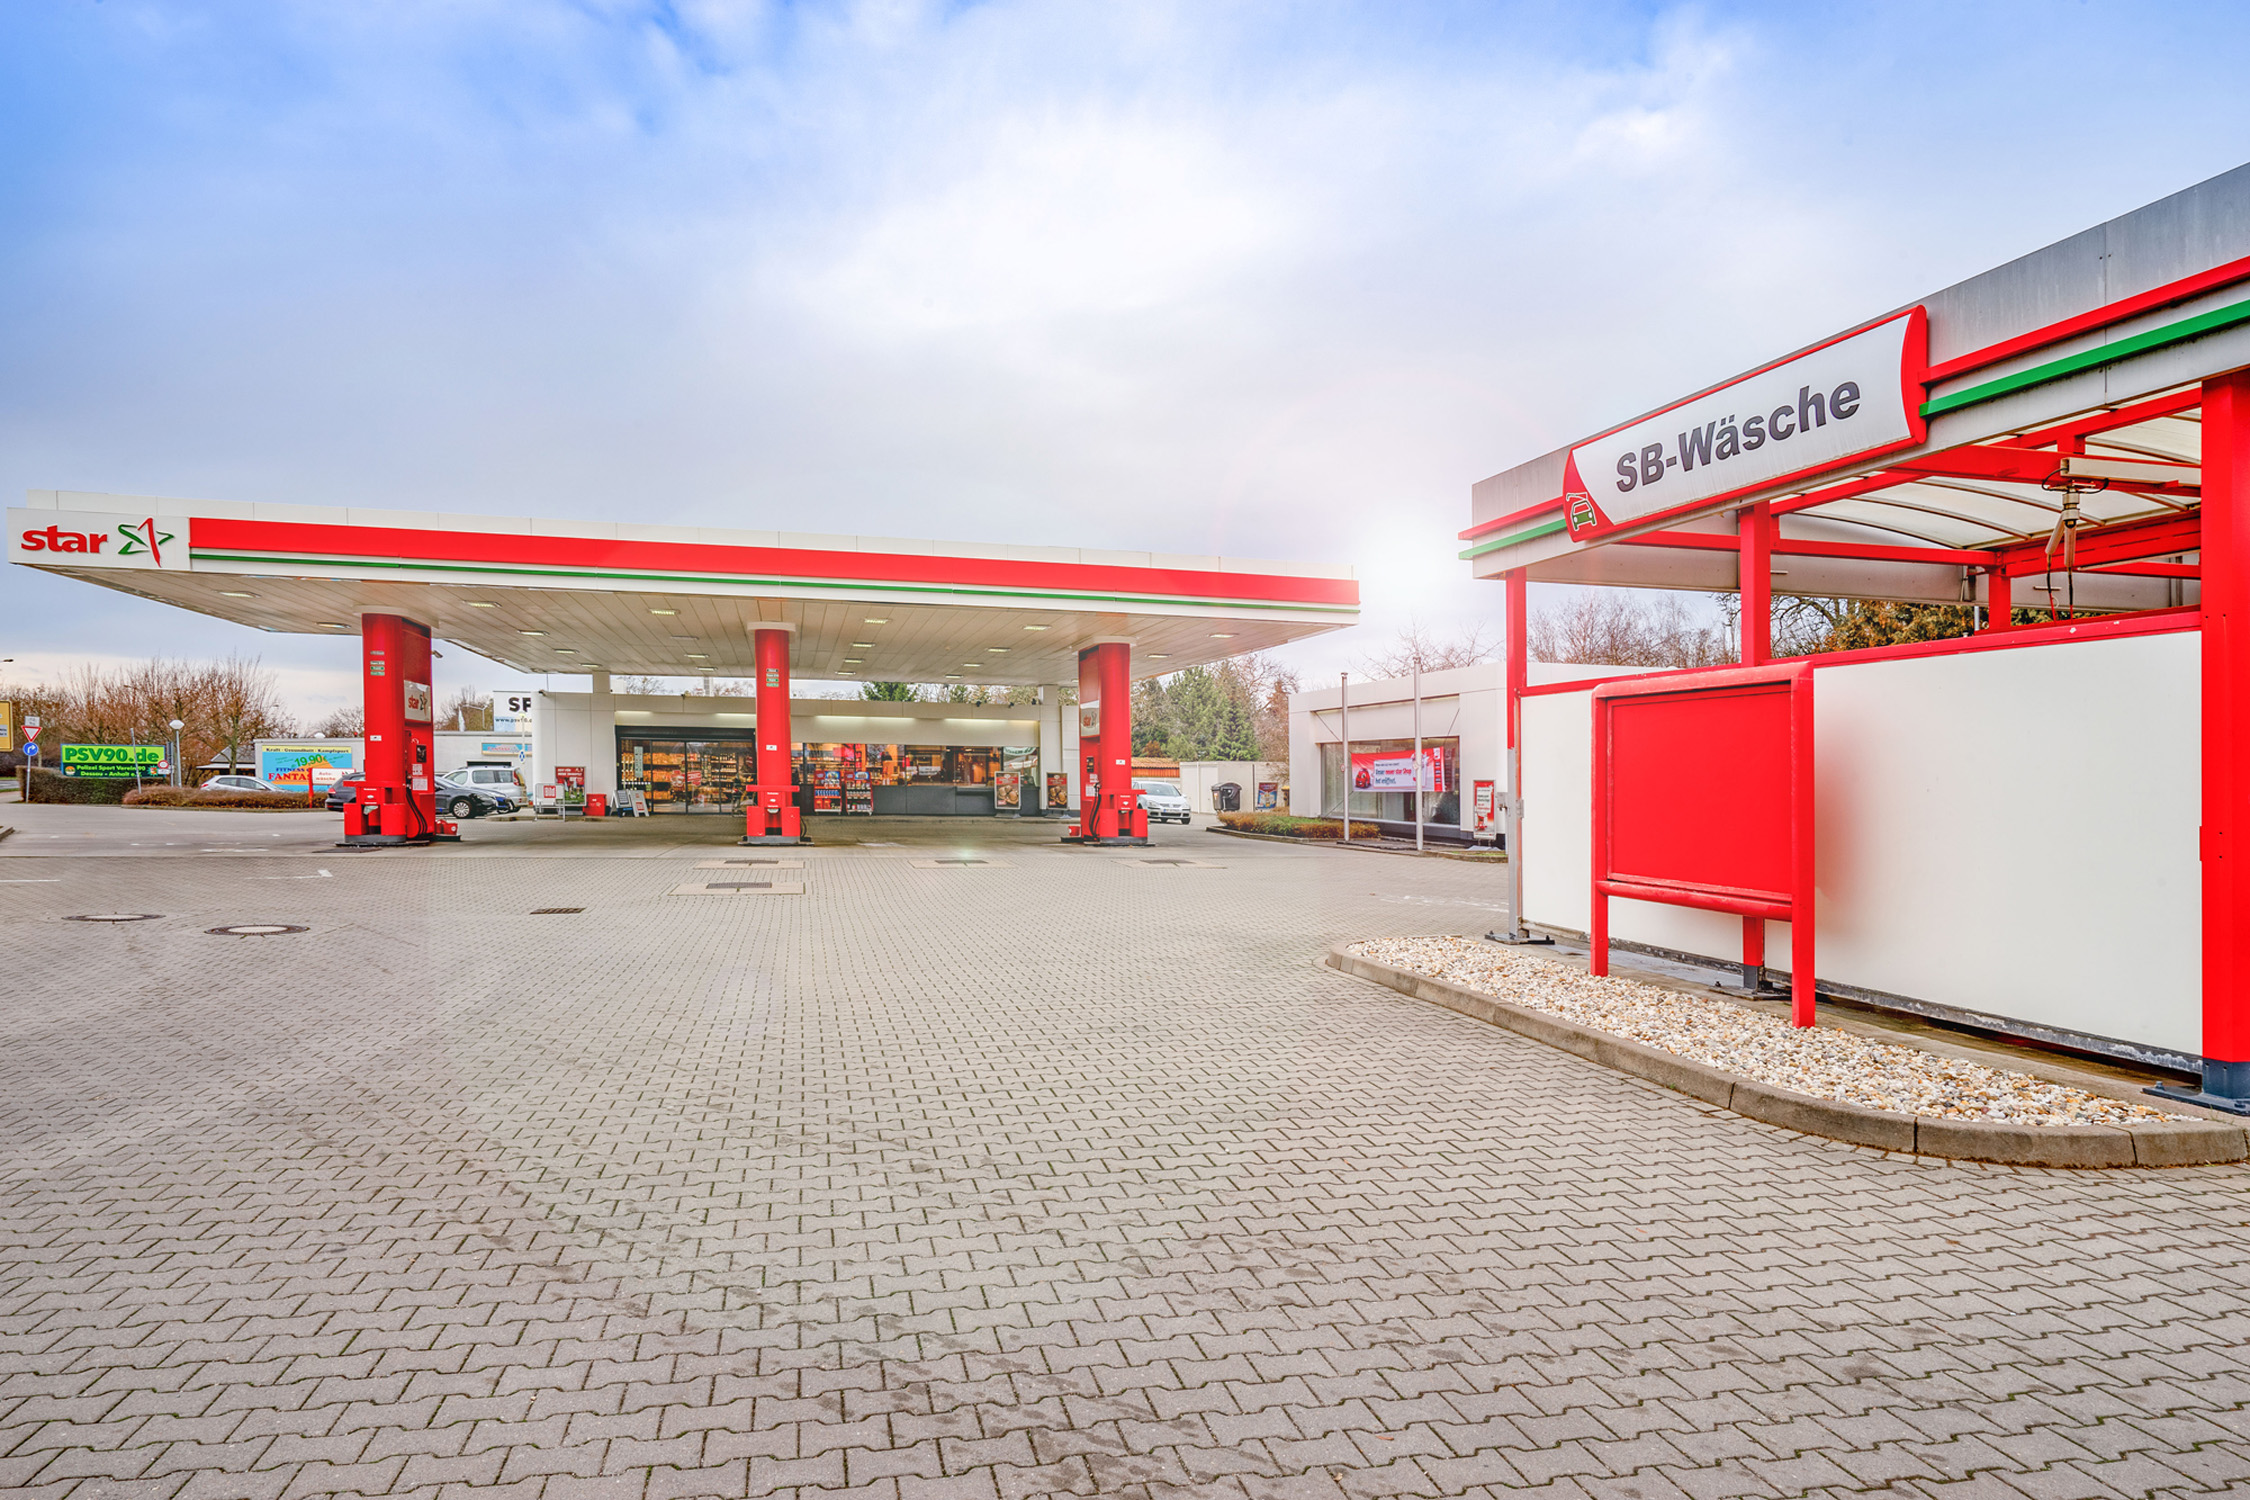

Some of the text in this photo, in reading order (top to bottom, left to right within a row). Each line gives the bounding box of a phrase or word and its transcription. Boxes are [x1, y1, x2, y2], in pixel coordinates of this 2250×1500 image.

[1616, 381, 1861, 493] SB-Wäsche
[21, 525, 108, 554] star
[65, 748, 159, 762] PSV90.de
